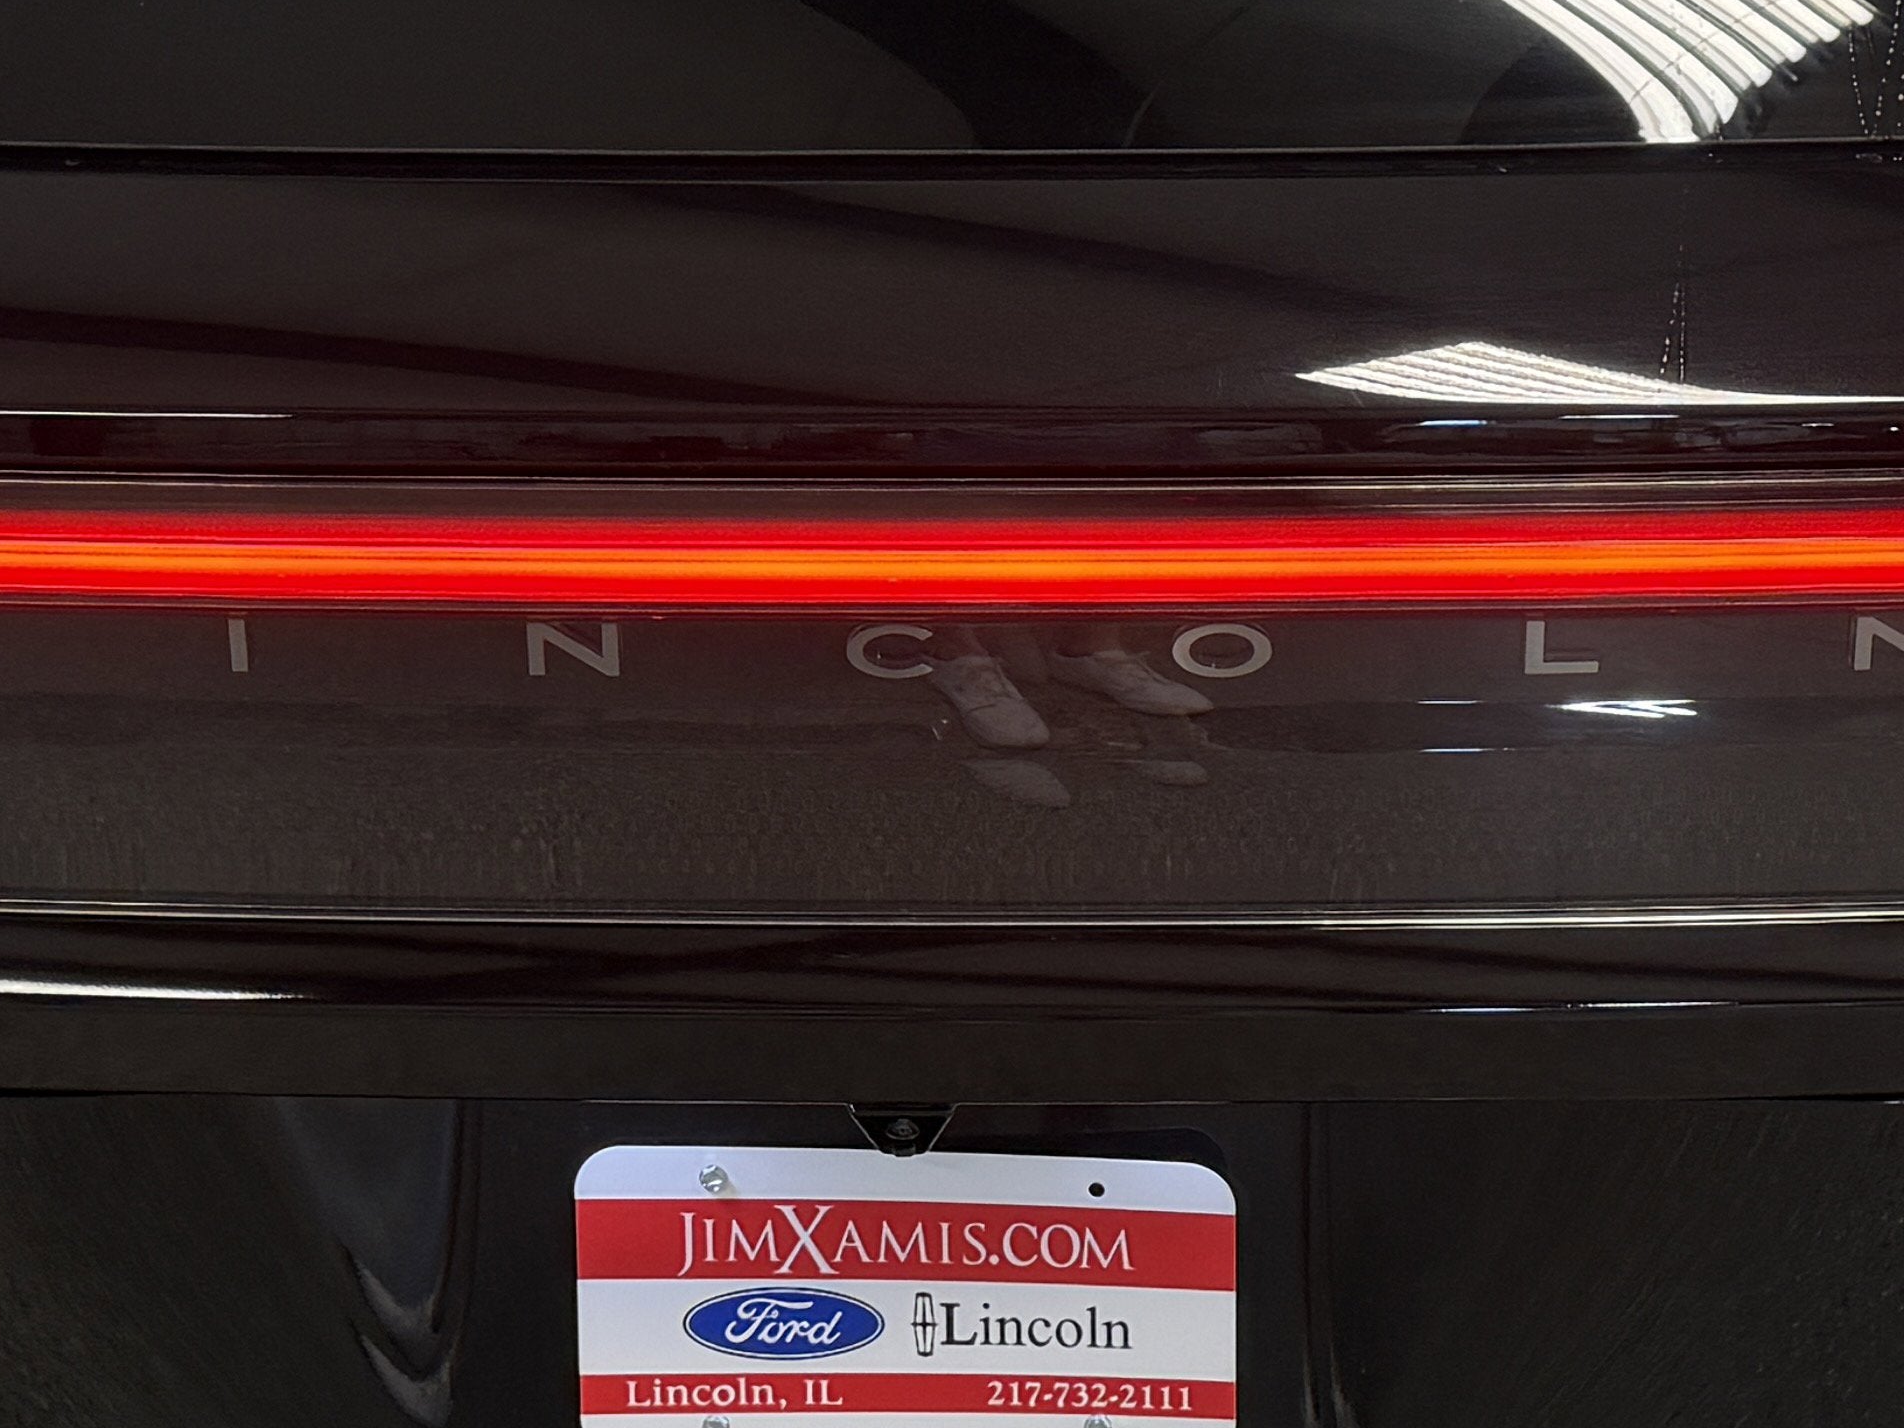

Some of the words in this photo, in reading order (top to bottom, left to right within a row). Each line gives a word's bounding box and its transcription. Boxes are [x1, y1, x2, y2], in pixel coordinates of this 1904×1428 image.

[723, 1297, 842, 1345] Ford
[940, 1301, 1133, 1350] Lincoln
[626, 1377, 787, 1410] Lincoln,
[804, 1379, 843, 1406] IL
[987, 1380, 1193, 1412] 217-732-2111
